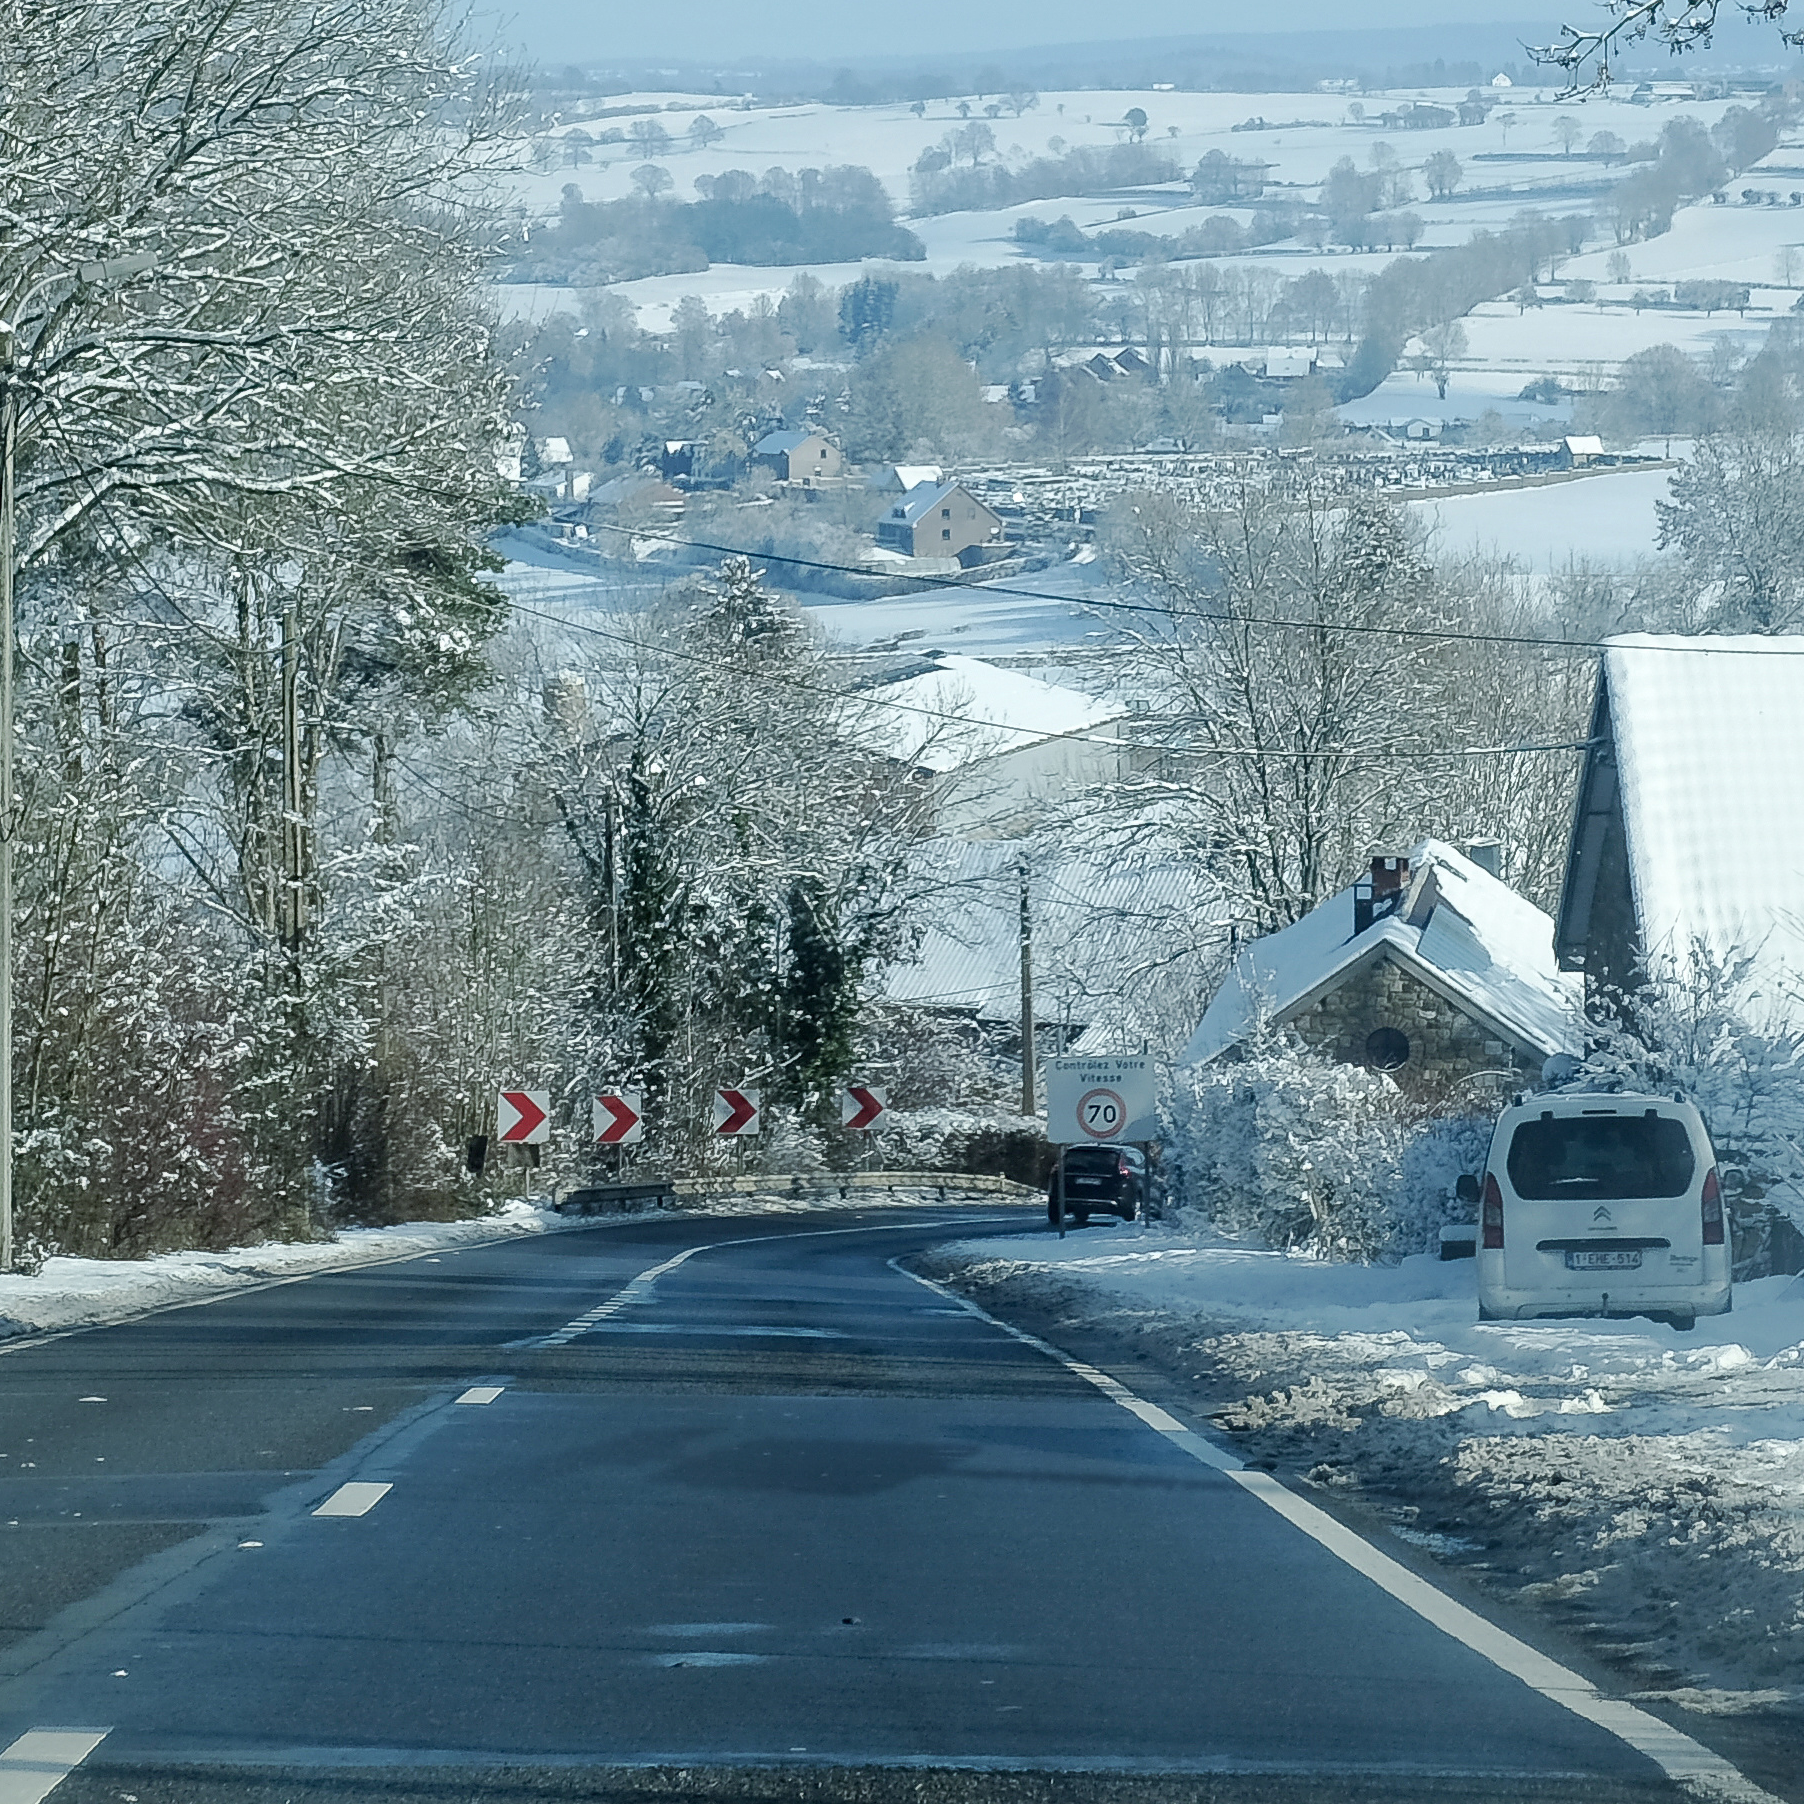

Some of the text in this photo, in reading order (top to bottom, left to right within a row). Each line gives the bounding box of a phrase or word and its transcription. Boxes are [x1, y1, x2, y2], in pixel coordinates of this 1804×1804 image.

[1115, 1059, 1146, 1069] Votre
[1080, 1073, 1122, 1083] Vitesse
[1087, 1104, 1117, 1124] 70
